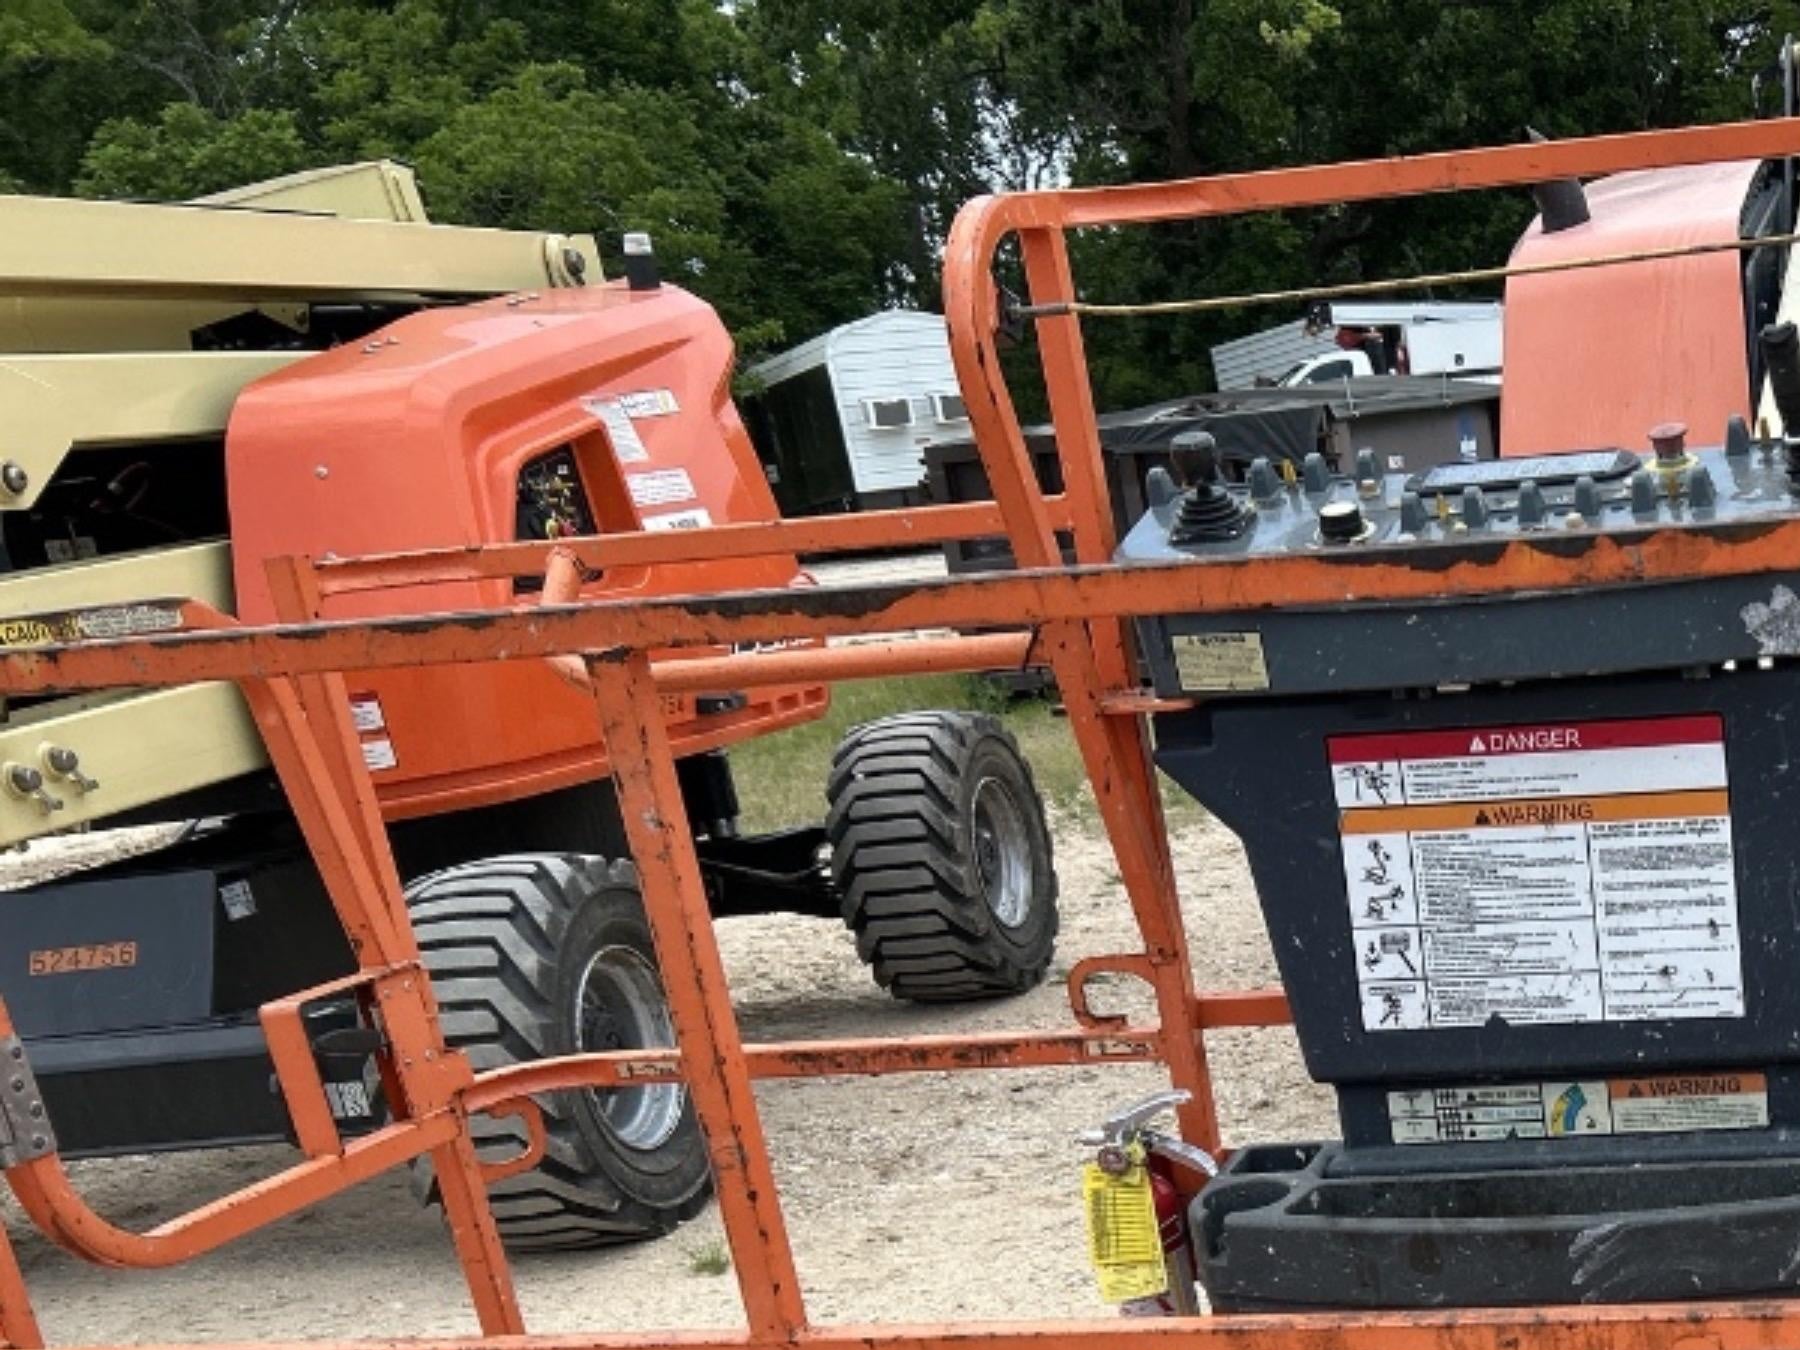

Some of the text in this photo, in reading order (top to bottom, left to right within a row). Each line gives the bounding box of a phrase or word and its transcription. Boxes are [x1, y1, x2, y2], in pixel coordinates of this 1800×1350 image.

[1489, 728, 1582, 751] DANGER
[1493, 801, 1594, 825] WARNING
[1650, 1077, 1741, 1097] WARNING
